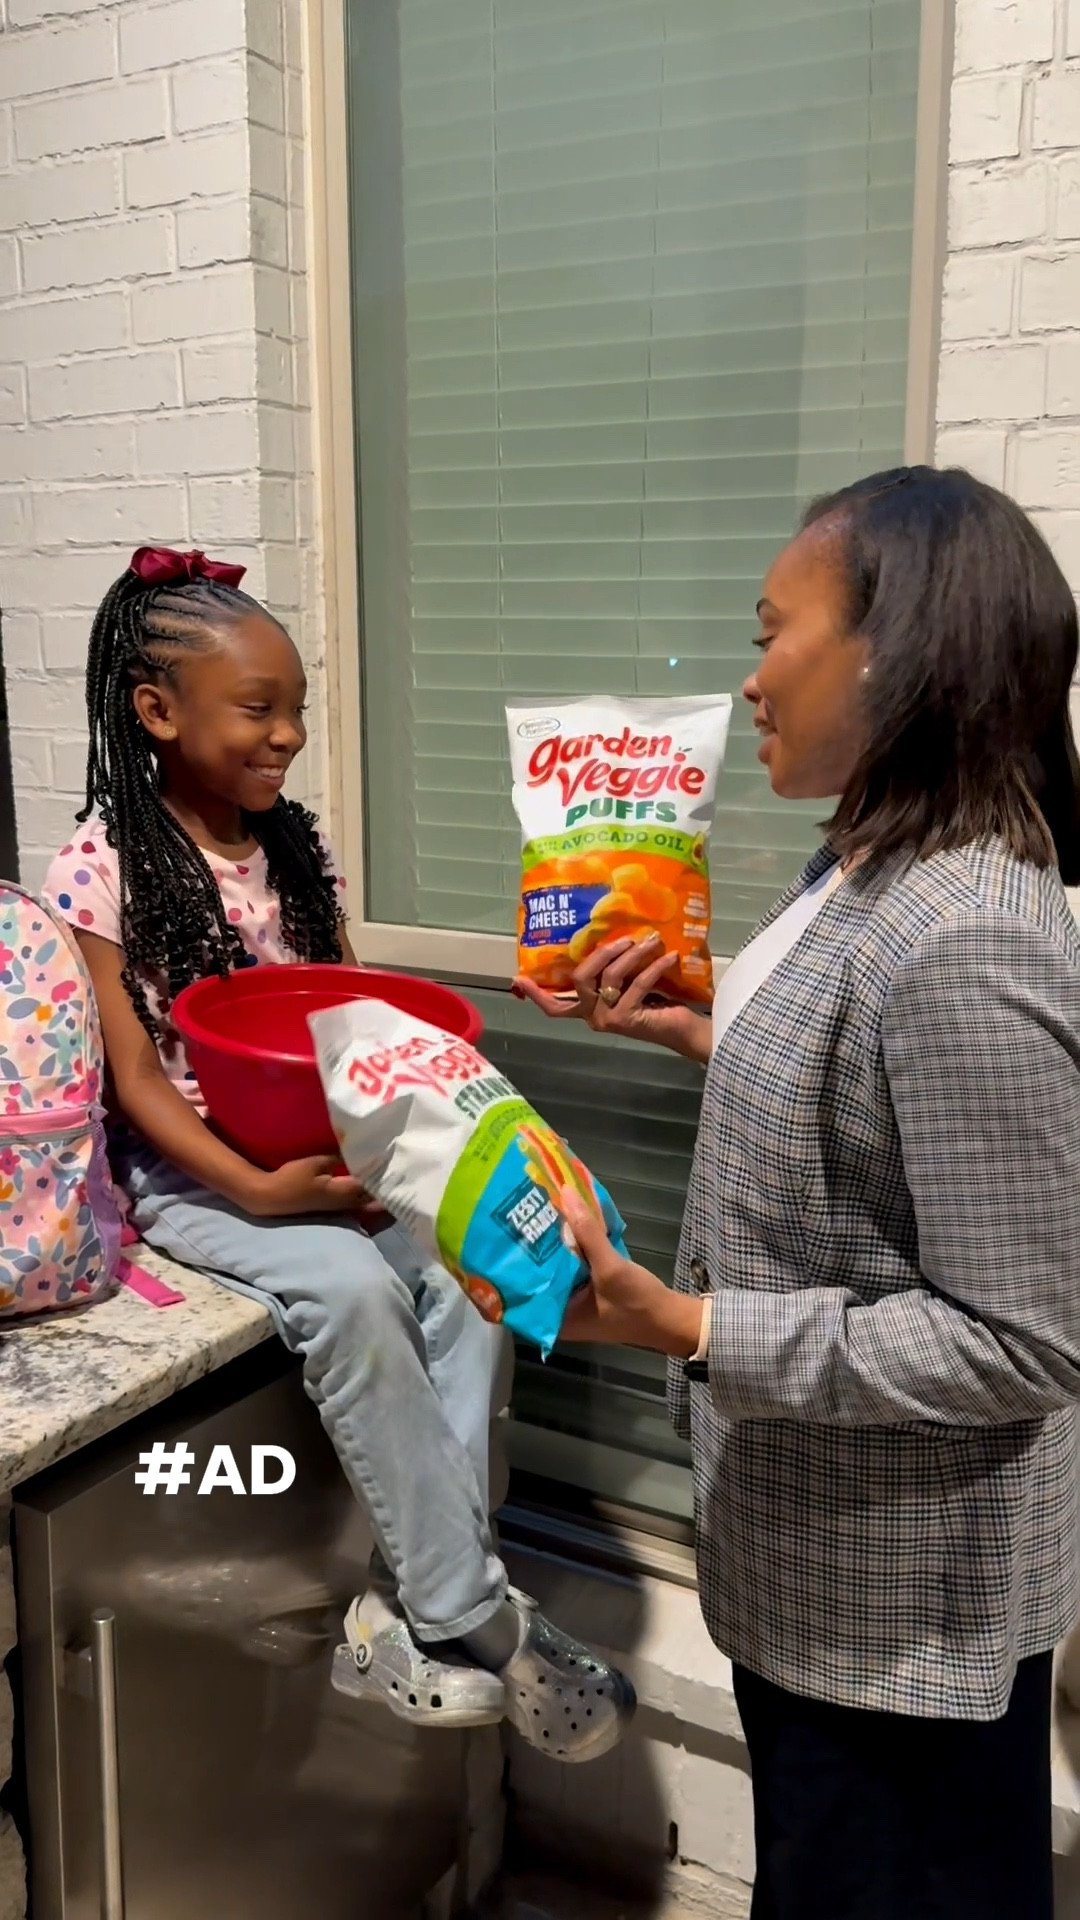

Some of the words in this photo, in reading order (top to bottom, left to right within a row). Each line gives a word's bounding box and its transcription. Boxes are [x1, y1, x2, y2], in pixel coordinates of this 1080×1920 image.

[527, 727, 672, 787] garden
[557, 752, 705, 807] Veggie
[565, 797, 677, 827] PUFFS
[562, 831, 648, 850] AVOCADO
[654, 833, 685, 851] OIL
[528, 894, 556, 914] MAC
[528, 909, 577, 930] CHEESE
[506, 1186, 545, 1230] ZESTY
